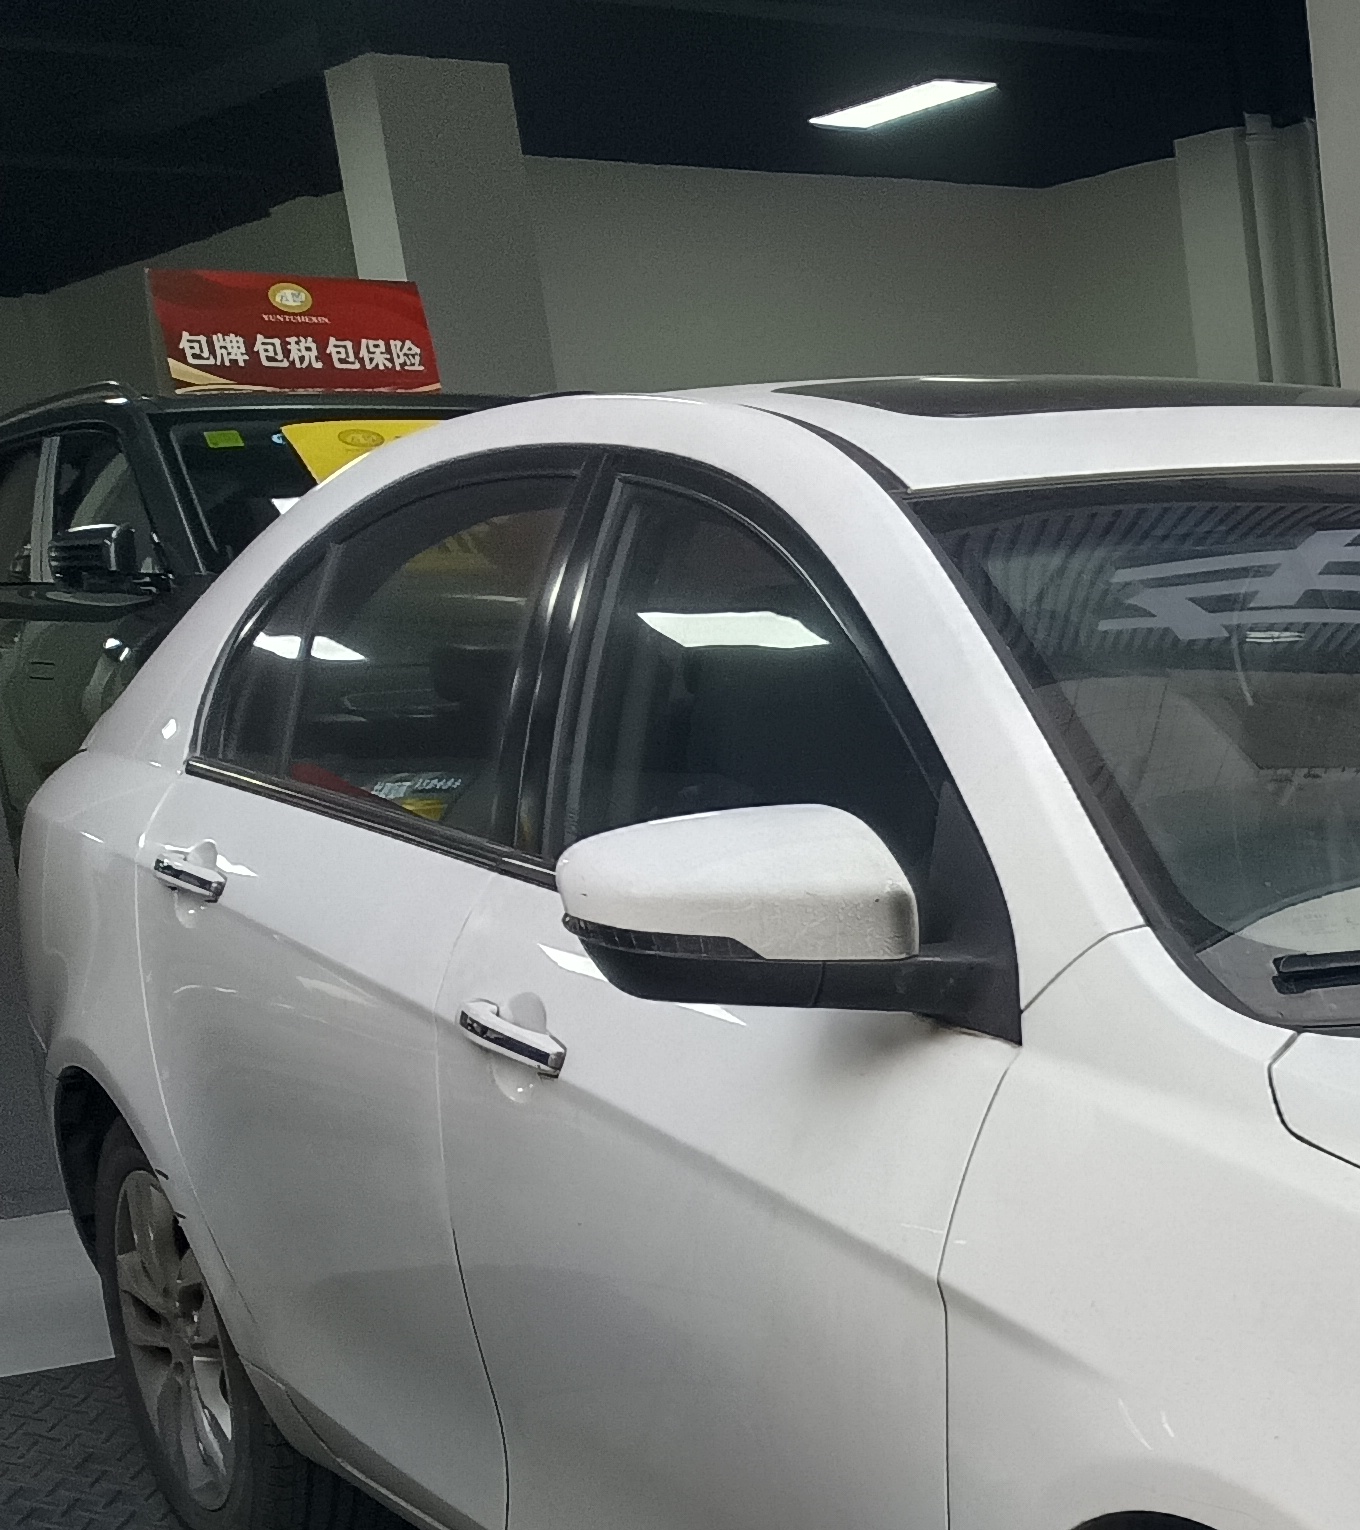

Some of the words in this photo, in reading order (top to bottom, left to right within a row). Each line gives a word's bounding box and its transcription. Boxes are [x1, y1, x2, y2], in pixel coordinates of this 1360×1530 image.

[179, 330, 249, 367] 包牌
[253, 333, 322, 370] 包税
[326, 336, 425, 371] 包保险
